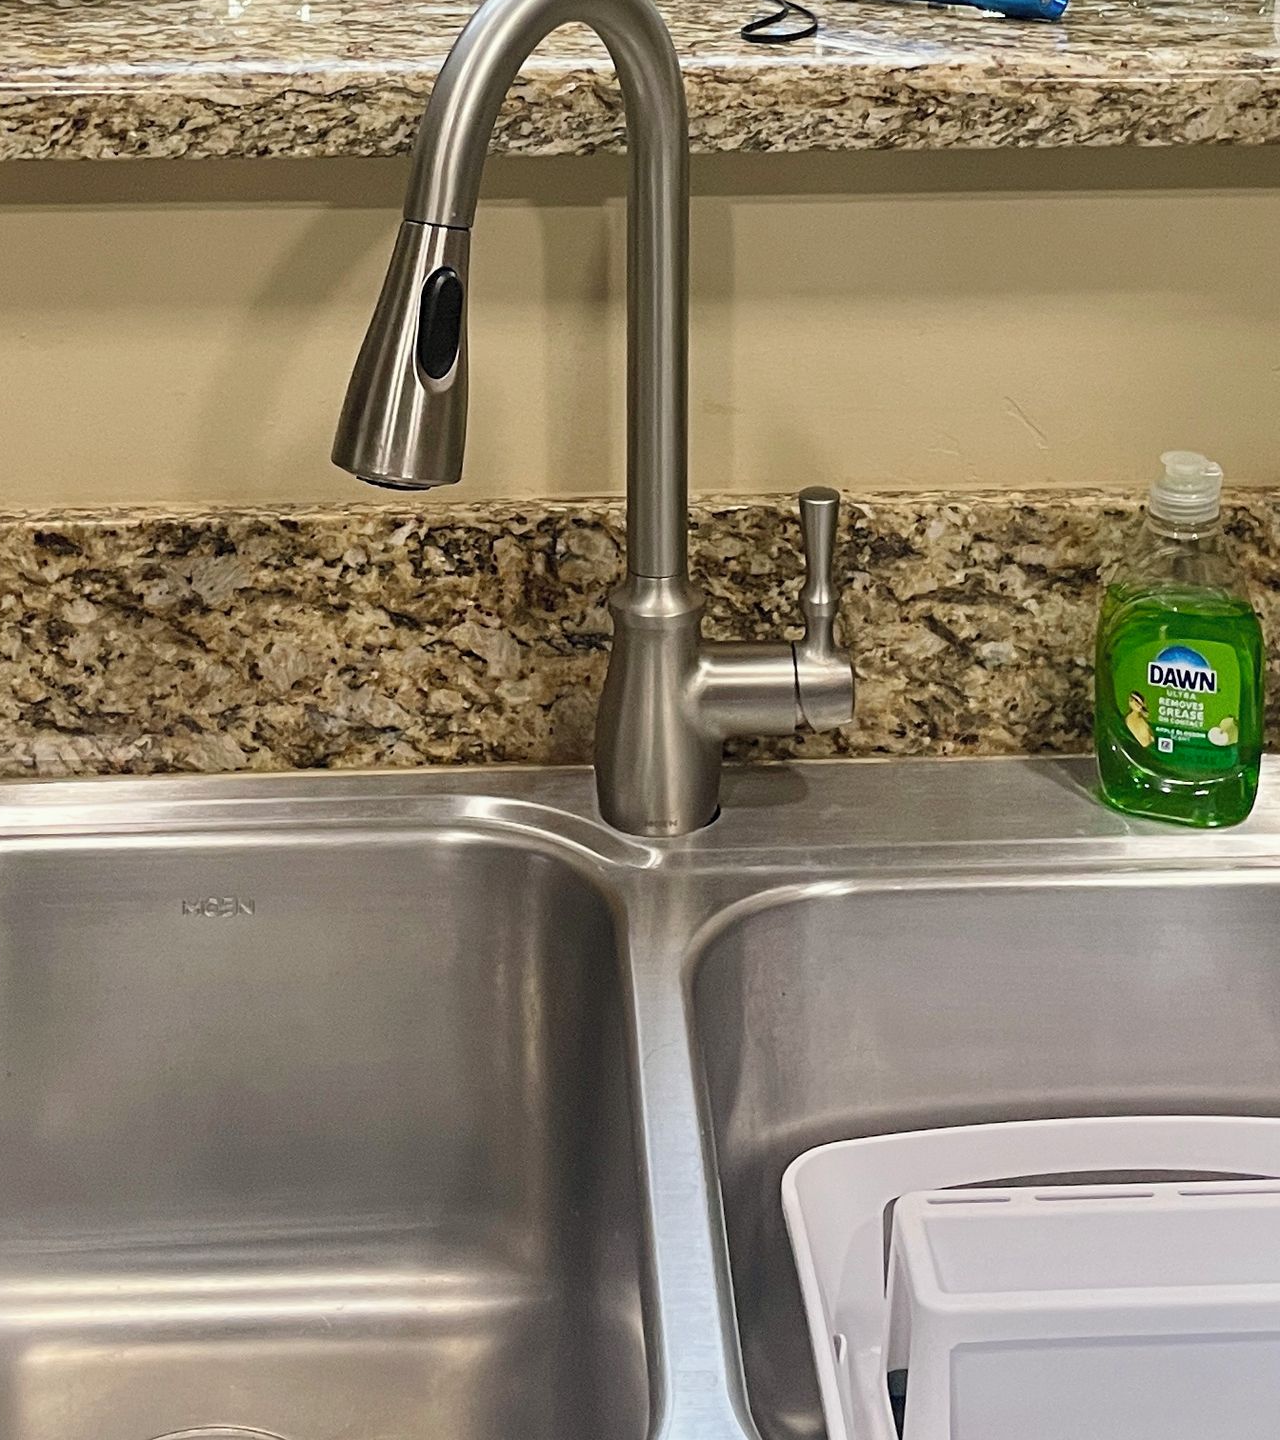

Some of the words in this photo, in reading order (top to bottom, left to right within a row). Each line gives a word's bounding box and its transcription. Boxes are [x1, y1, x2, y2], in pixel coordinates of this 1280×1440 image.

[1150, 664, 1215, 691] DAWN
[1166, 690, 1196, 700] ULTRA
[1158, 697, 1204, 710] REMOVES
[1158, 706, 1204, 720] GREASE
[182, 895, 256, 918] MOEN
